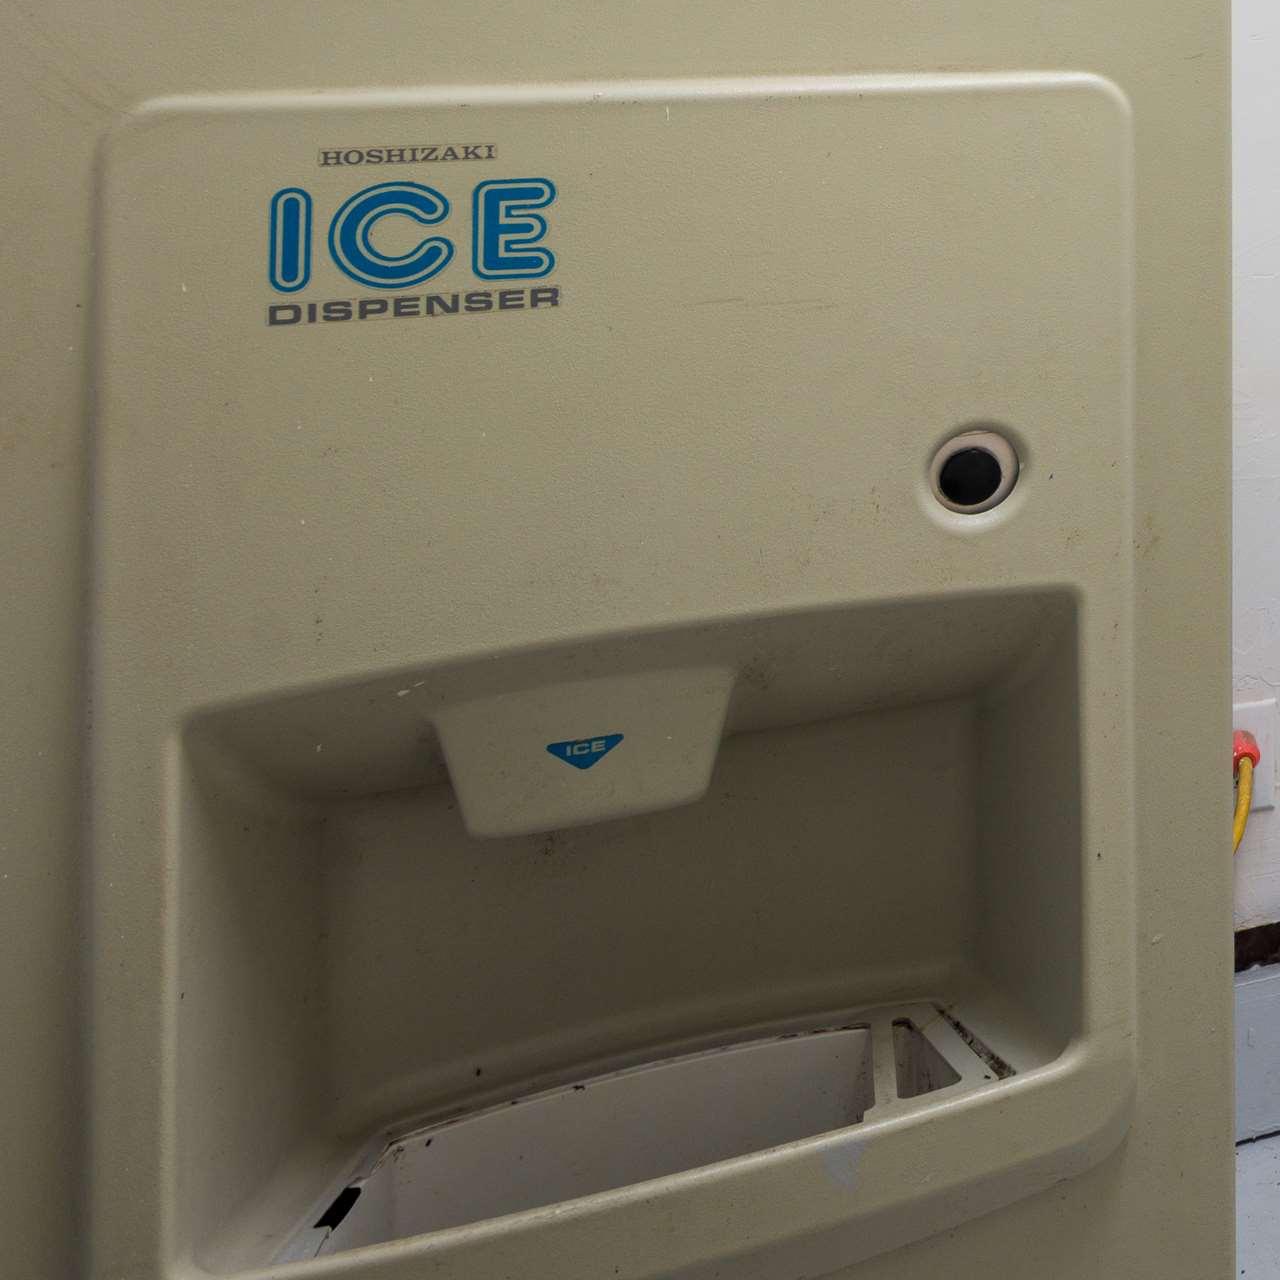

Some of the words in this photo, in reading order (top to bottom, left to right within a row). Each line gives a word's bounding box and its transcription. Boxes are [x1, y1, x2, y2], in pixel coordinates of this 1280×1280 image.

[320, 144, 496, 166] HOSHIZAKI
[269, 177, 557, 294] ICE
[268, 287, 560, 326] DISPENSER
[566, 739, 606, 757] ICE
